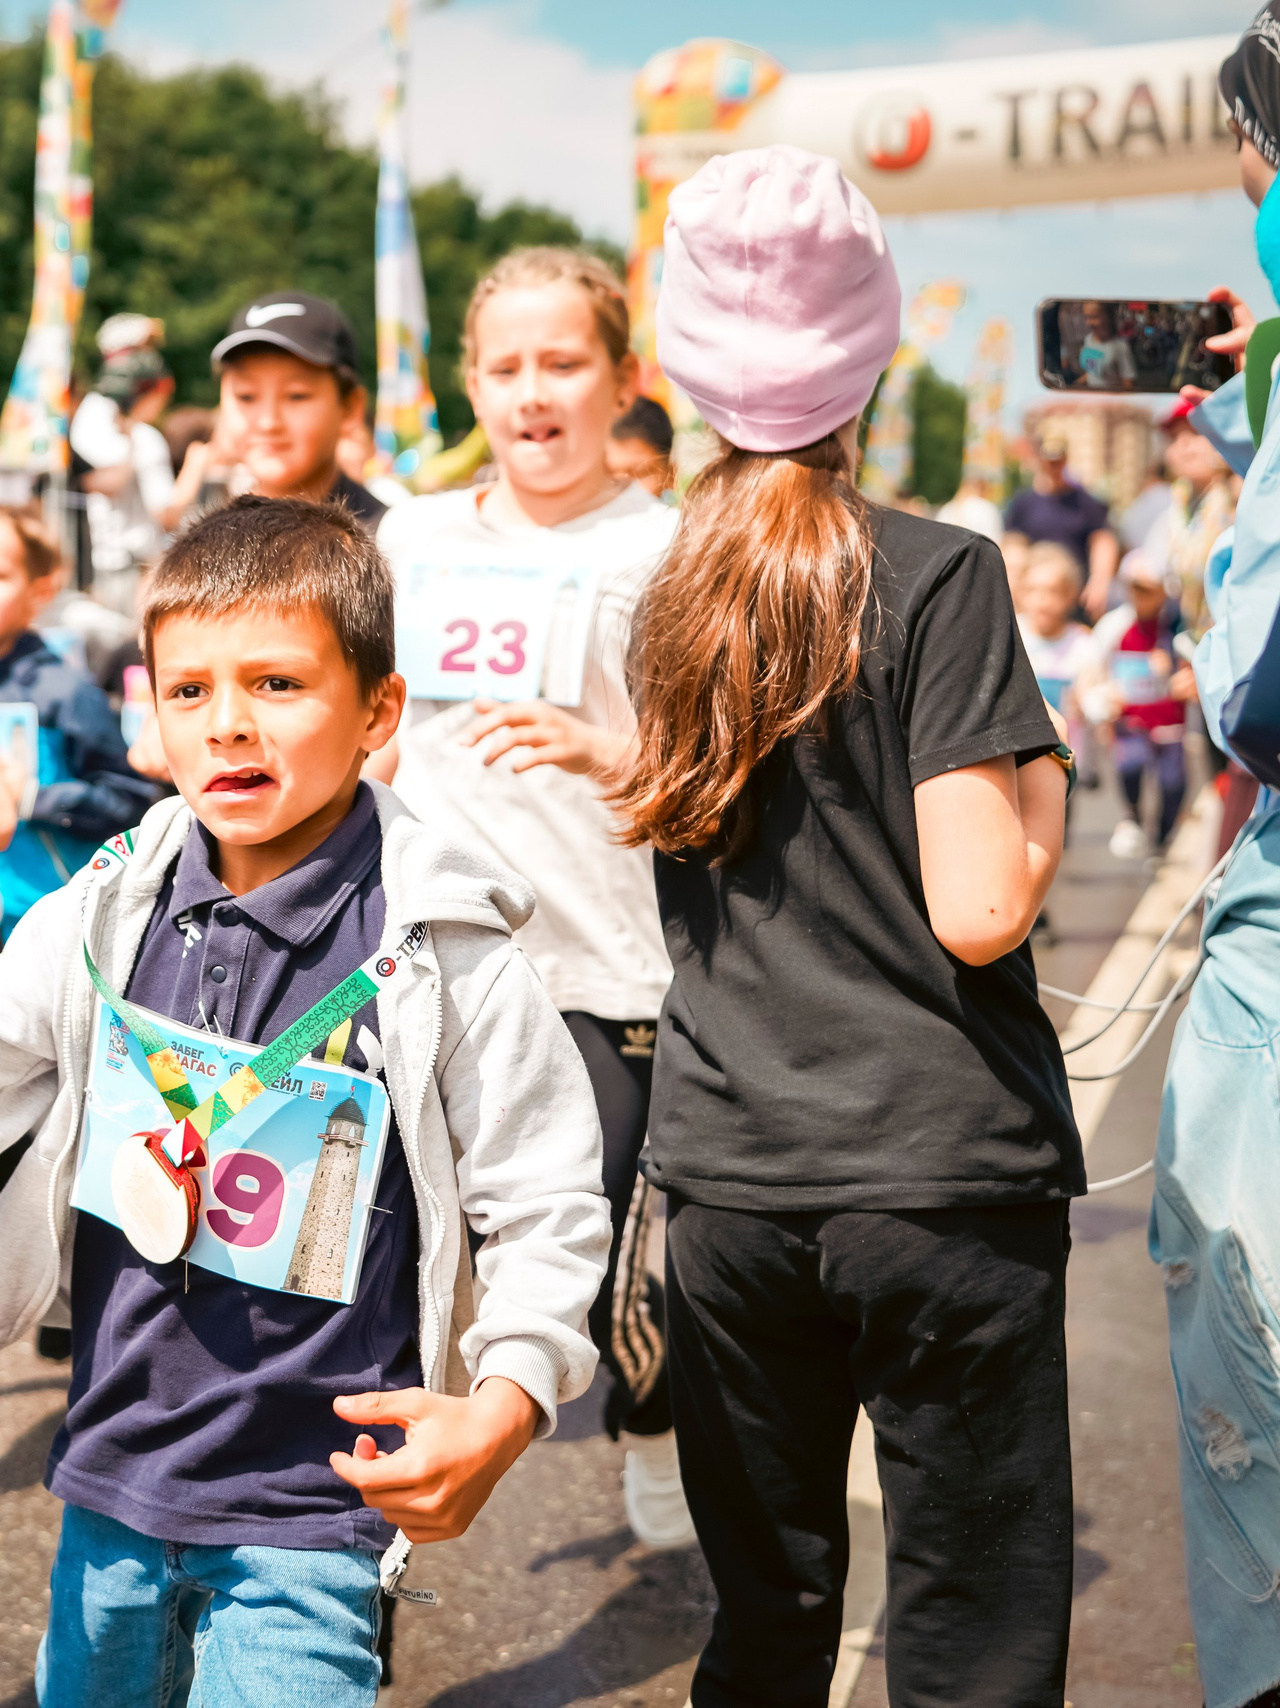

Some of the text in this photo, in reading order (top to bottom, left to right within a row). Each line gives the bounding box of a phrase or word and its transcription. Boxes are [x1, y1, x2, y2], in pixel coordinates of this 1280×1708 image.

[439, 618, 528, 676] 23
[170, 1040, 205, 1060] ЗАБЕГ
[176, 1053, 217, 1077] АГАС
[167, 1131, 285, 1248] 9
